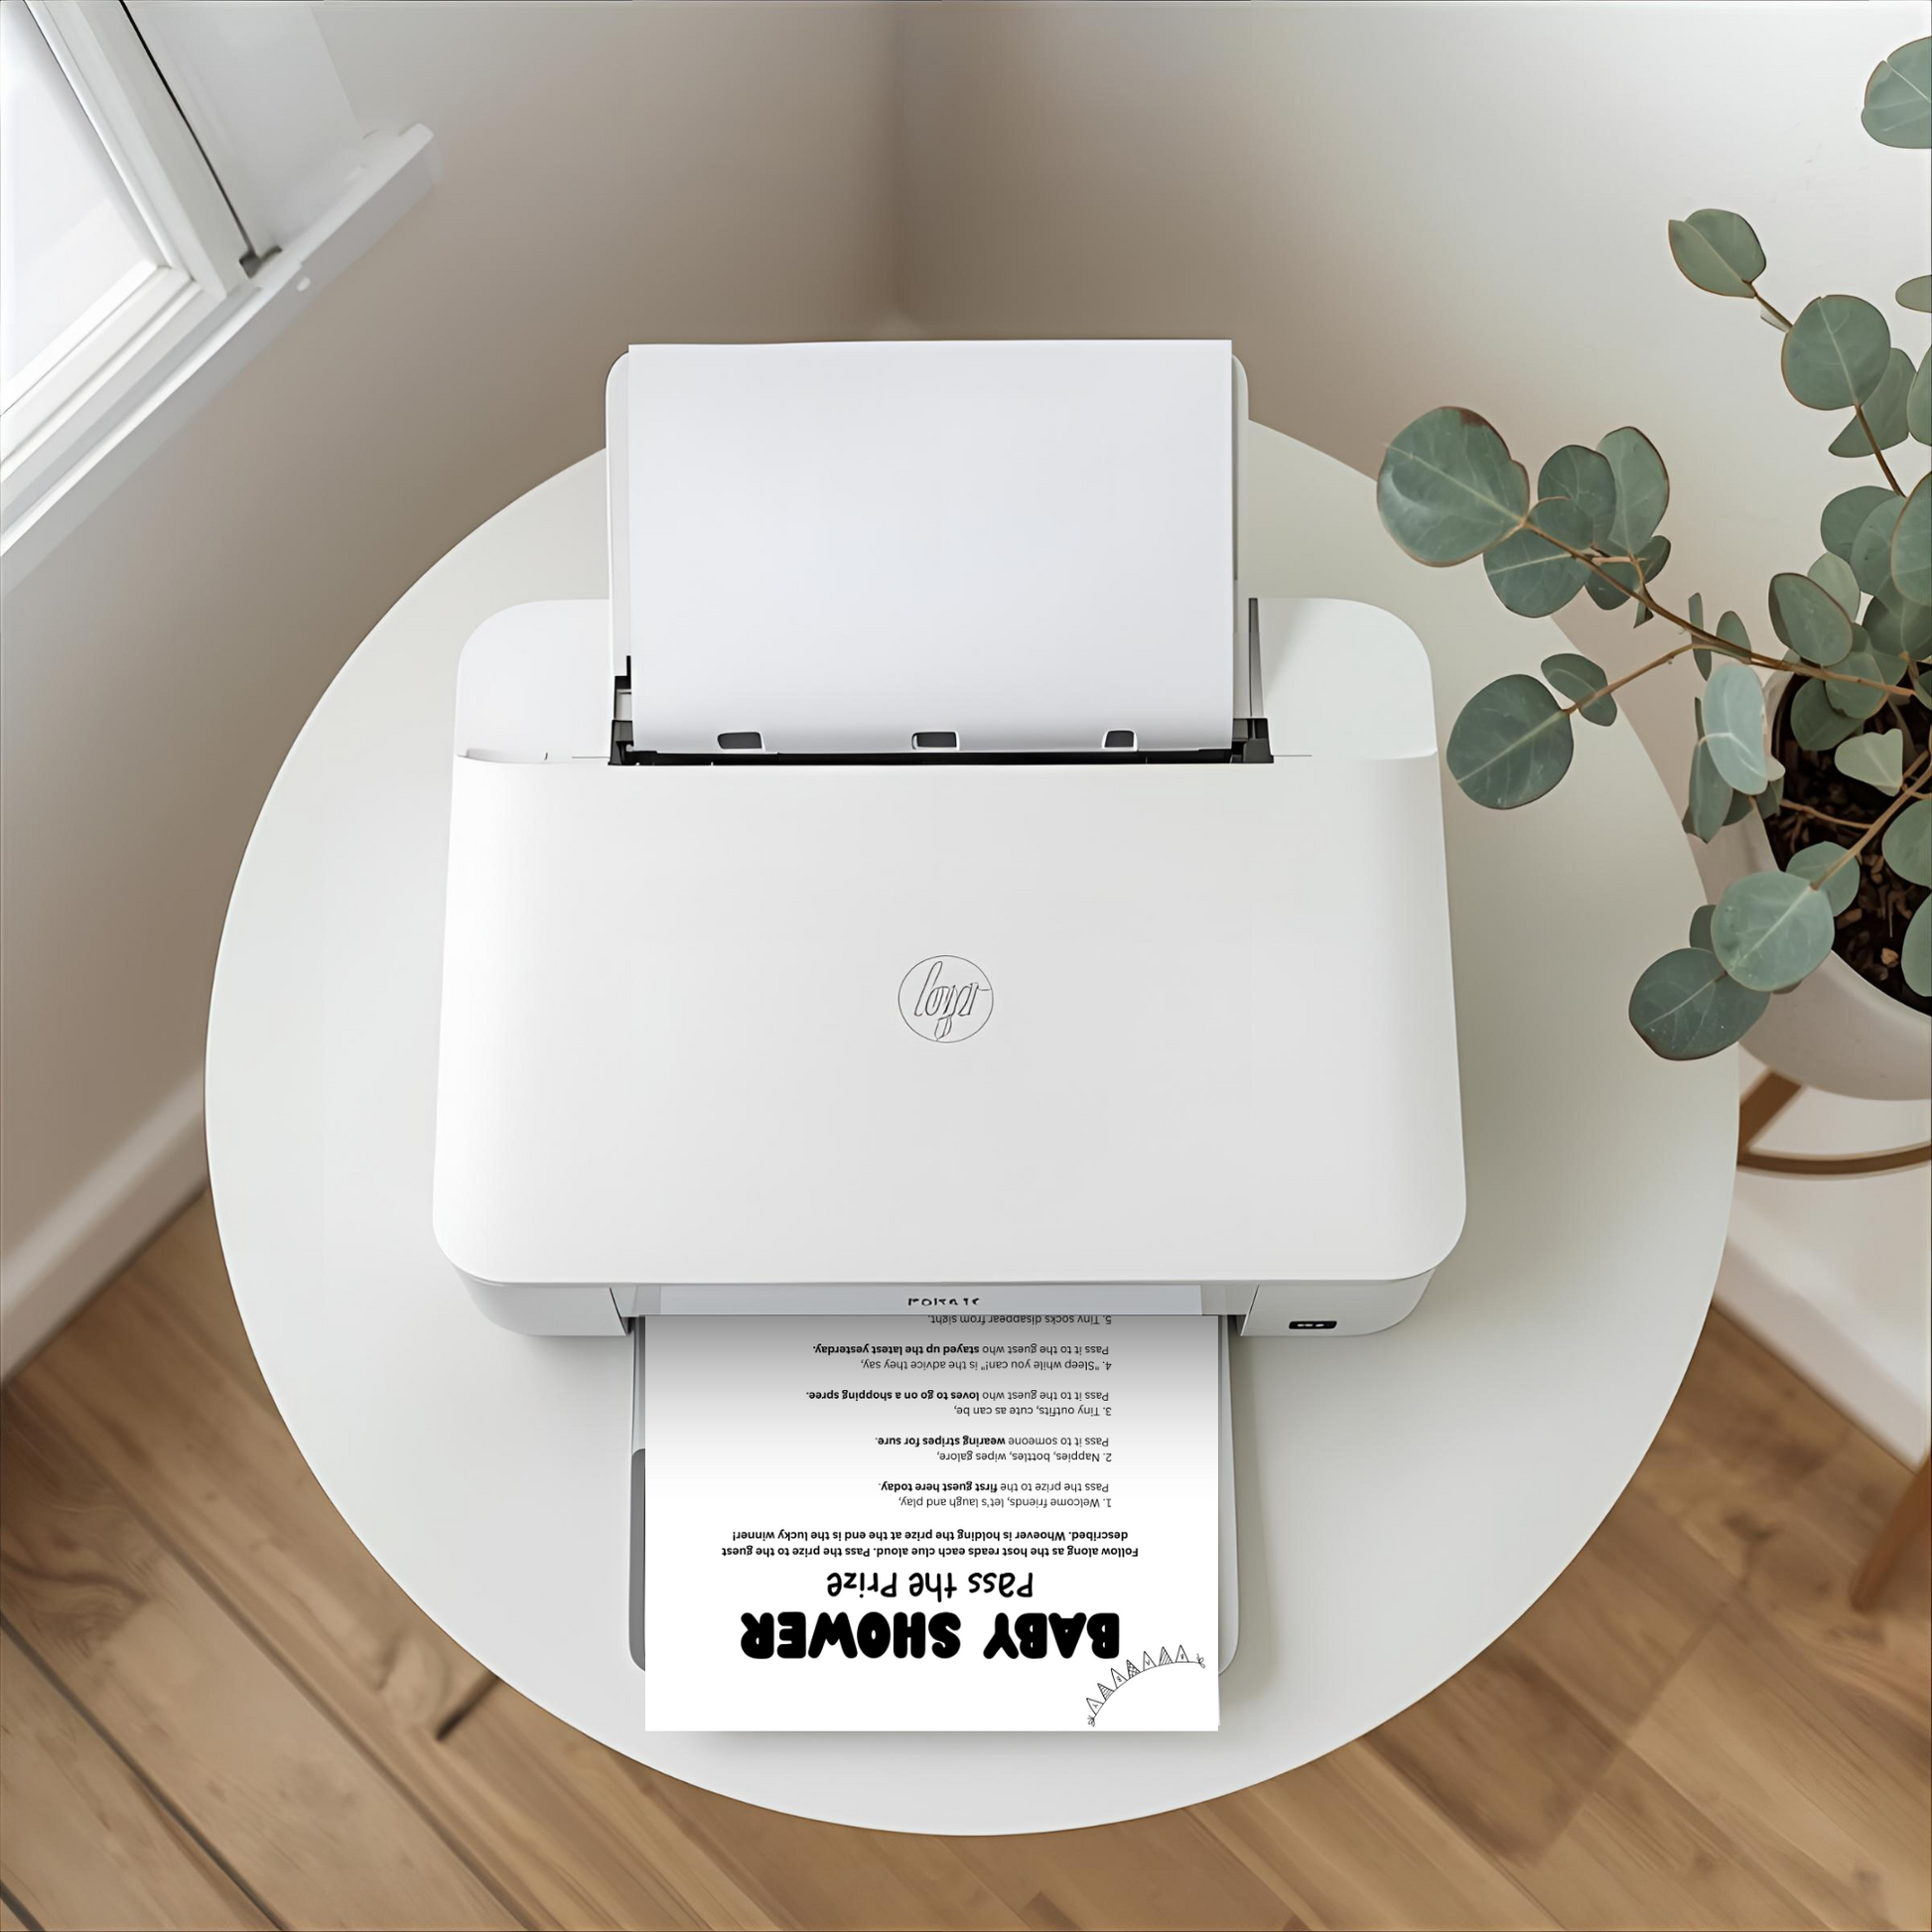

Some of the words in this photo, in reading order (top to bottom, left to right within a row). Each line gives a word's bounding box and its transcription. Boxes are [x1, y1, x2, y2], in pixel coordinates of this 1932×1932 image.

[960, 1314, 986, 1325] from
[1044, 1314, 1074, 1325] socks
[1102, 1314, 1112, 1325] 5.
[812, 1342, 870, 1355] yesterday.
[872, 1345, 902, 1355] latest
[905, 1346, 923, 1355] the
[926, 1343, 940, 1353] up
[943, 1343, 979, 1355] stayed
[982, 1346, 1005, 1355] who
[1008, 1343, 1037, 1354] guest
[1038, 1345, 1057, 1355] the
[1074, 1346, 1081, 1355] it
[1085, 1346, 1108, 1355] Pass
[861, 1359, 881, 1369] say,
[884, 1359, 907, 1370] they
[910, 1361, 946, 1370] advice
[948, 1361, 966, 1370] the
[969, 1361, 977, 1370] is
[981, 1361, 1008, 1370] can!"
[1011, 1359, 1031, 1369] you
[1034, 1361, 1061, 1370] while
[1064, 1359, 1099, 1370] "Sleep
[1103, 1361, 1112, 1370] 4.
[806, 1390, 839, 1399] spree.
[842, 1390, 893, 1401] shopping
[920, 1390, 934, 1400] go
[950, 1392, 979, 1401] loves
[982, 1392, 1005, 1401] who
[1008, 1390, 1036, 1400] guest
[1039, 1392, 1057, 1401] the
[1074, 1392, 1081, 1401] it
[1085, 1392, 1108, 1401] Pass
[954, 1406, 970, 1417] be,
[1010, 1407, 1034, 1416] cute
[1036, 1406, 1074, 1417] outfits,
[1078, 1405, 1100, 1417] Tiny
[1103, 1407, 1111, 1416] 3.
[903, 1438, 920, 1448] for
[922, 1436, 960, 1448] stripes
[963, 1436, 1006, 1448] wearing
[1060, 1438, 1071, 1447] to
[1074, 1438, 1081, 1448] it
[1085, 1438, 1108, 1447] Pass
[937, 1450, 973, 1462] galore,
[976, 1450, 1007, 1462] wipes
[1010, 1451, 1049, 1462] bottles,
[1053, 1450, 1099, 1462] Nappies,
[1103, 1453, 1111, 1462] 2.
[879, 1481, 912, 1492] today.
[915, 1483, 939, 1492] here
[942, 1481, 972, 1491] guest
[975, 1483, 998, 1493] first
[1001, 1483, 1018, 1492] the
[1035, 1481, 1061, 1492] prize
[1064, 1483, 1082, 1492] the
[1085, 1483, 1108, 1492] Pass
[898, 1496, 923, 1508] play,
[927, 1498, 946, 1508] and
[949, 1496, 978, 1508] laugh
[982, 1498, 1004, 1508] let's
[1008, 1497, 1047, 1508] friends,
[1050, 1498, 1100, 1508] Welcome
[1103, 1498, 1111, 1507] 1.
[732, 1531, 775, 1541] winner!
[777, 1528, 807, 1541] lucky
[811, 1532, 830, 1541] the
[833, 1532, 841, 1541] is
[845, 1532, 866, 1541] end
[869, 1532, 888, 1541] the
[904, 1529, 932, 1541] prize
[936, 1532, 954, 1541] the
[956, 1528, 1000, 1541] holding
[1003, 1532, 1012, 1541] is
[1015, 1532, 1065, 1541] Whoever
[1068, 1532, 1128, 1541] described.
[722, 1545, 753, 1556] guest
[756, 1548, 774, 1558] the
[792, 1546, 820, 1558] prize
[823, 1548, 842, 1558] the
[845, 1548, 870, 1557] Pass
[874, 1548, 908, 1558] aloud.
[911, 1548, 935, 1558] clue
[938, 1548, 965, 1558] each
[968, 1548, 999, 1558] reads
[1002, 1548, 1028, 1558] host
[1031, 1548, 1049, 1558] the
[1067, 1545, 1098, 1558] along
[1101, 1548, 1138, 1558] Follow
[827, 1573, 897, 1598] Prize
[908, 1573, 957, 1602] the
[968, 1573, 1033, 1597] Pass
[741, 1611, 961, 1659] SHOWER
[983, 1612, 1120, 1659] BABY
